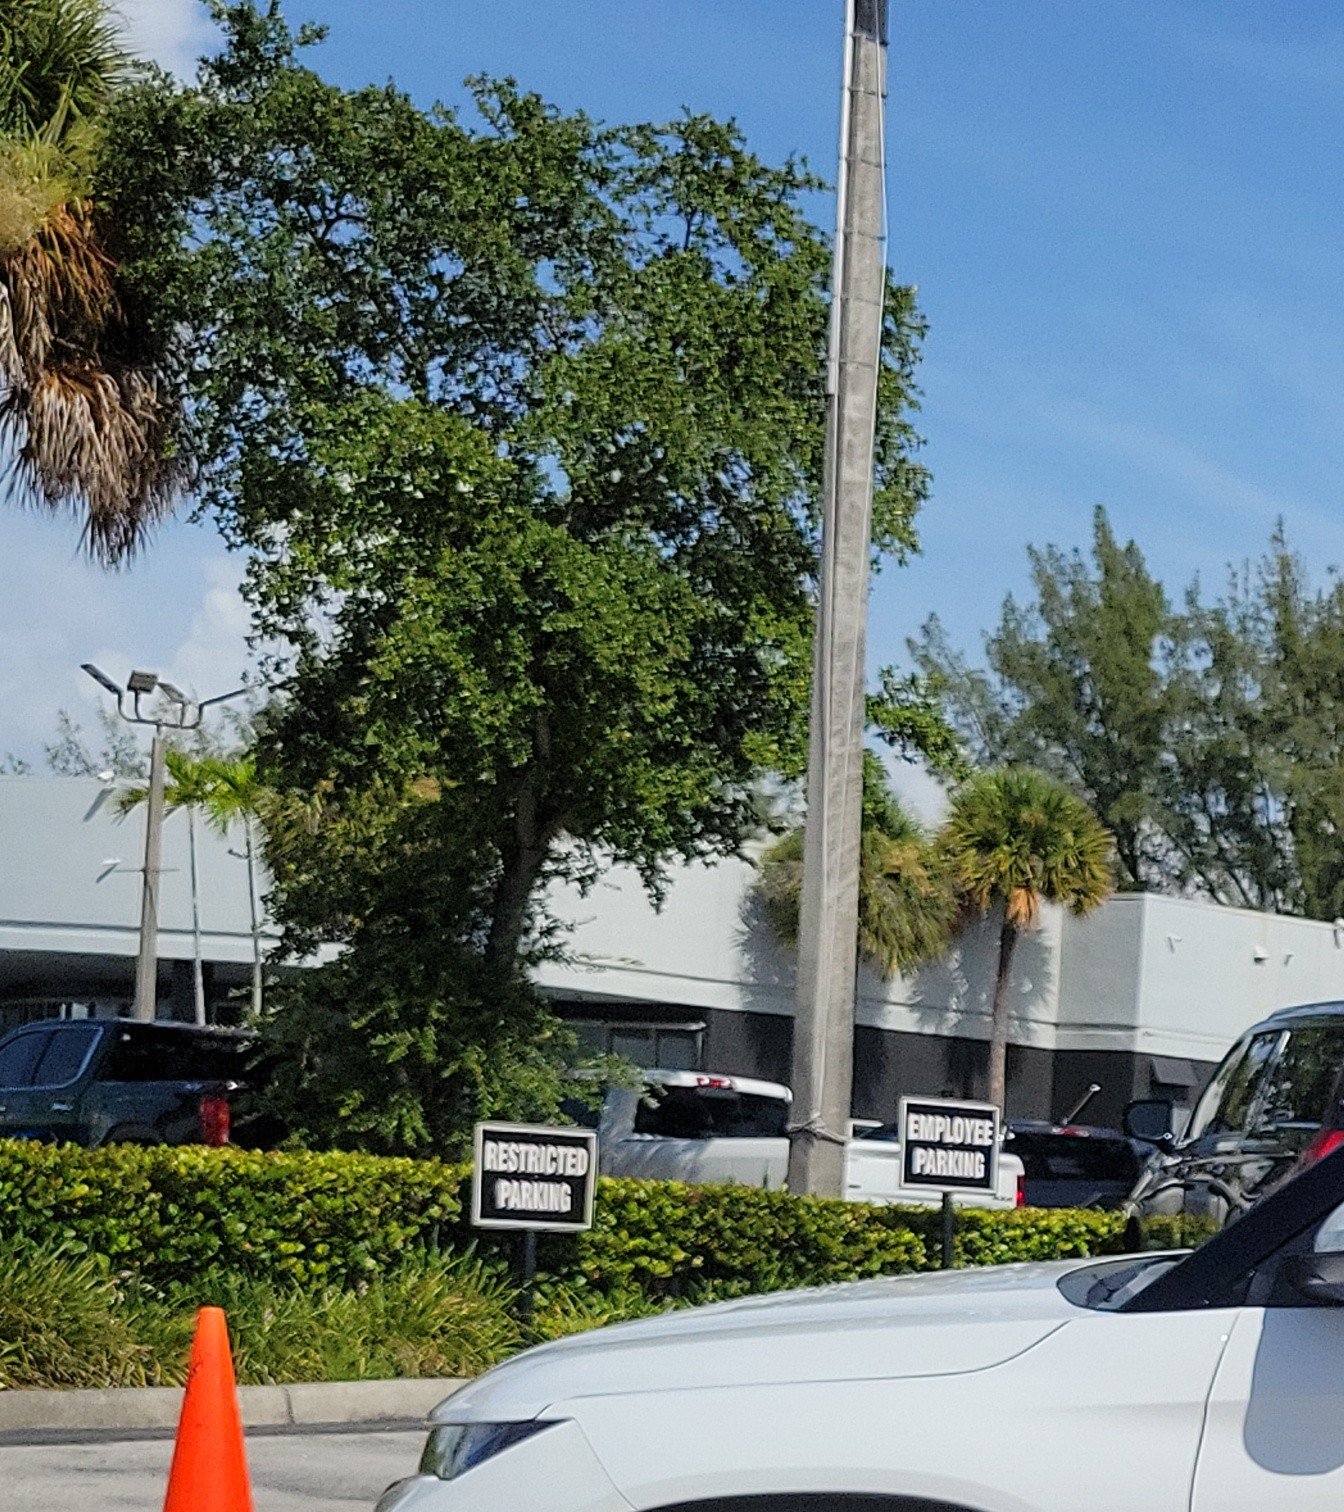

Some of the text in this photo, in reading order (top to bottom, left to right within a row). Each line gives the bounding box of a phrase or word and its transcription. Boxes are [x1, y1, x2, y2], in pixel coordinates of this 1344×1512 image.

[907, 1112, 994, 1146] EMPLOYEE
[483, 1140, 589, 1176] RESTRICTED
[911, 1146, 985, 1179] PARKING
[494, 1178, 572, 1213] PARKING
